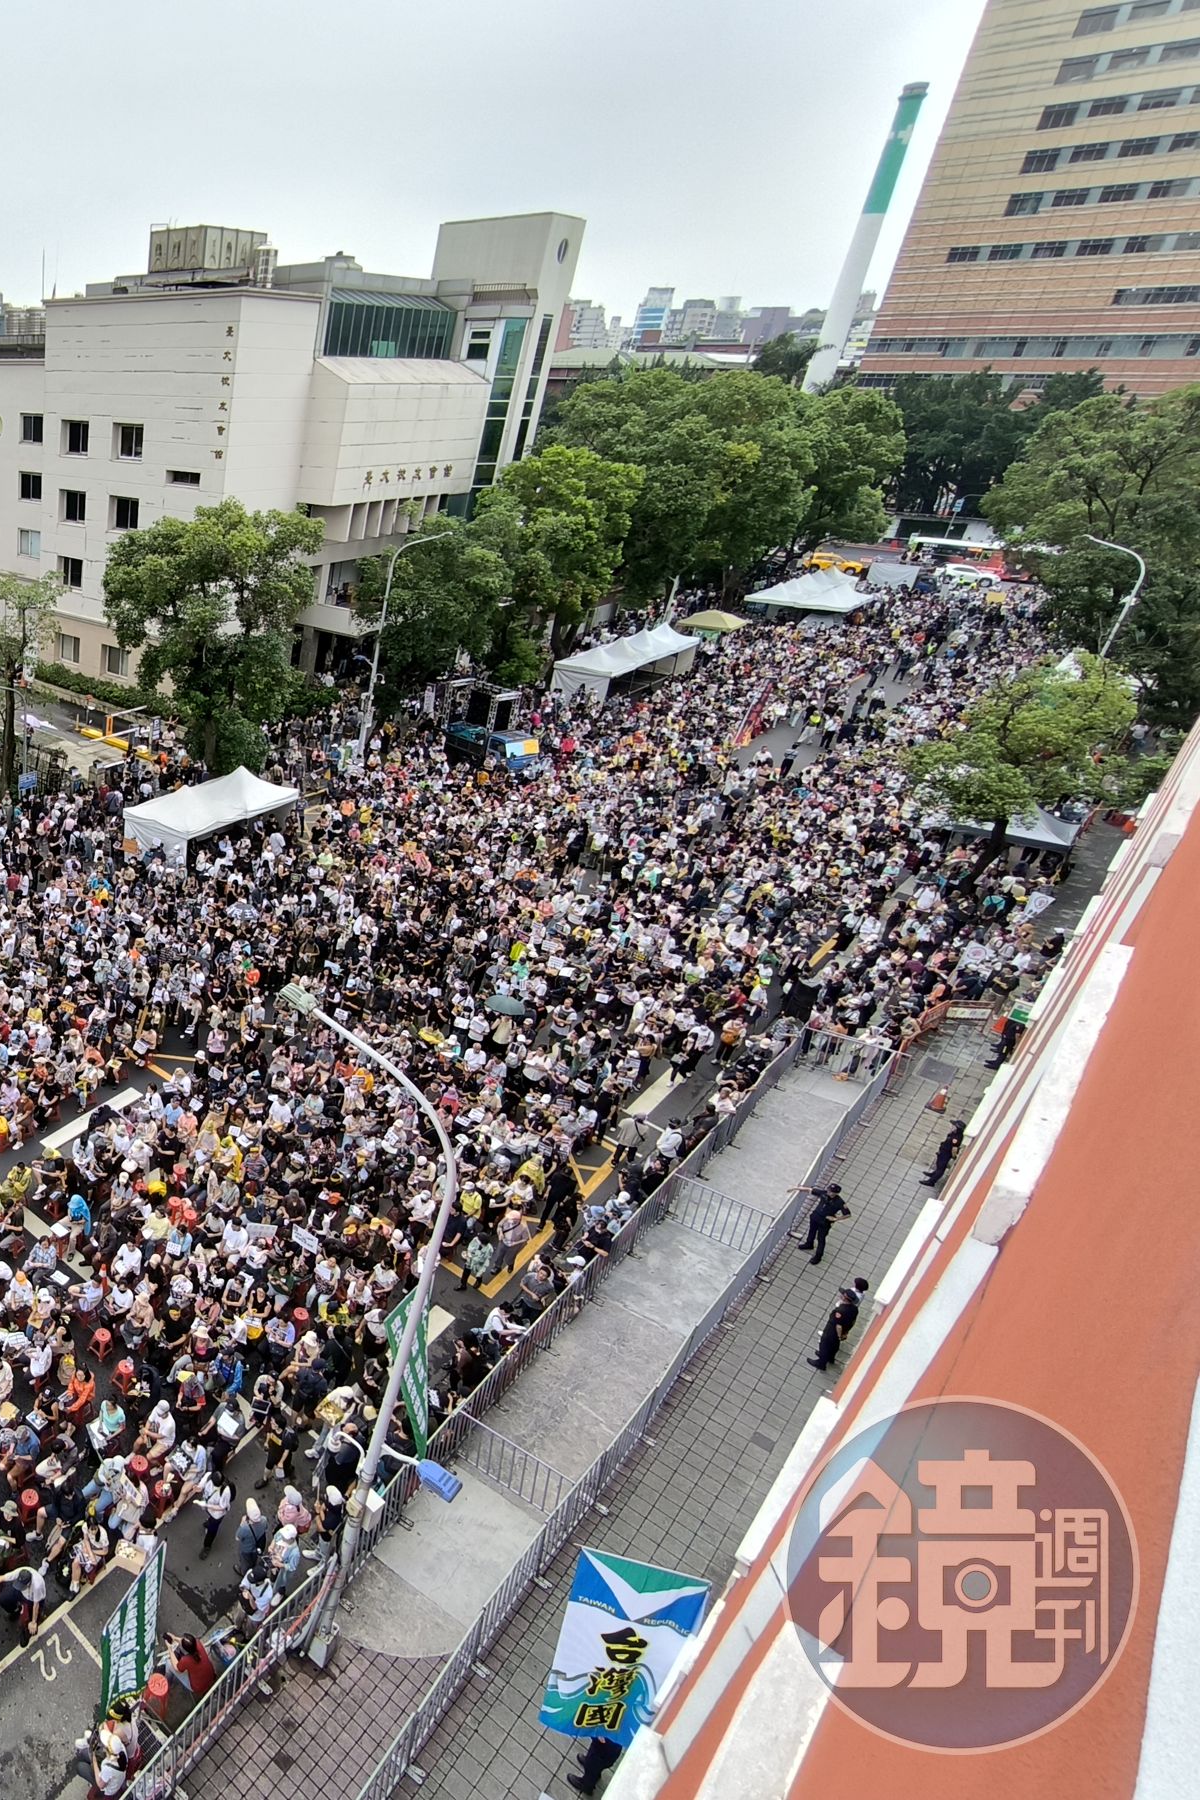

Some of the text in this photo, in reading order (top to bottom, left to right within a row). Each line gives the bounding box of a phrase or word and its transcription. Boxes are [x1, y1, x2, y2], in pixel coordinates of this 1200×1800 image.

[577, 1595, 616, 1614] TAIWAN
[30, 1632, 73, 1681] 22
[573, 1626, 649, 1731] 台灣國
